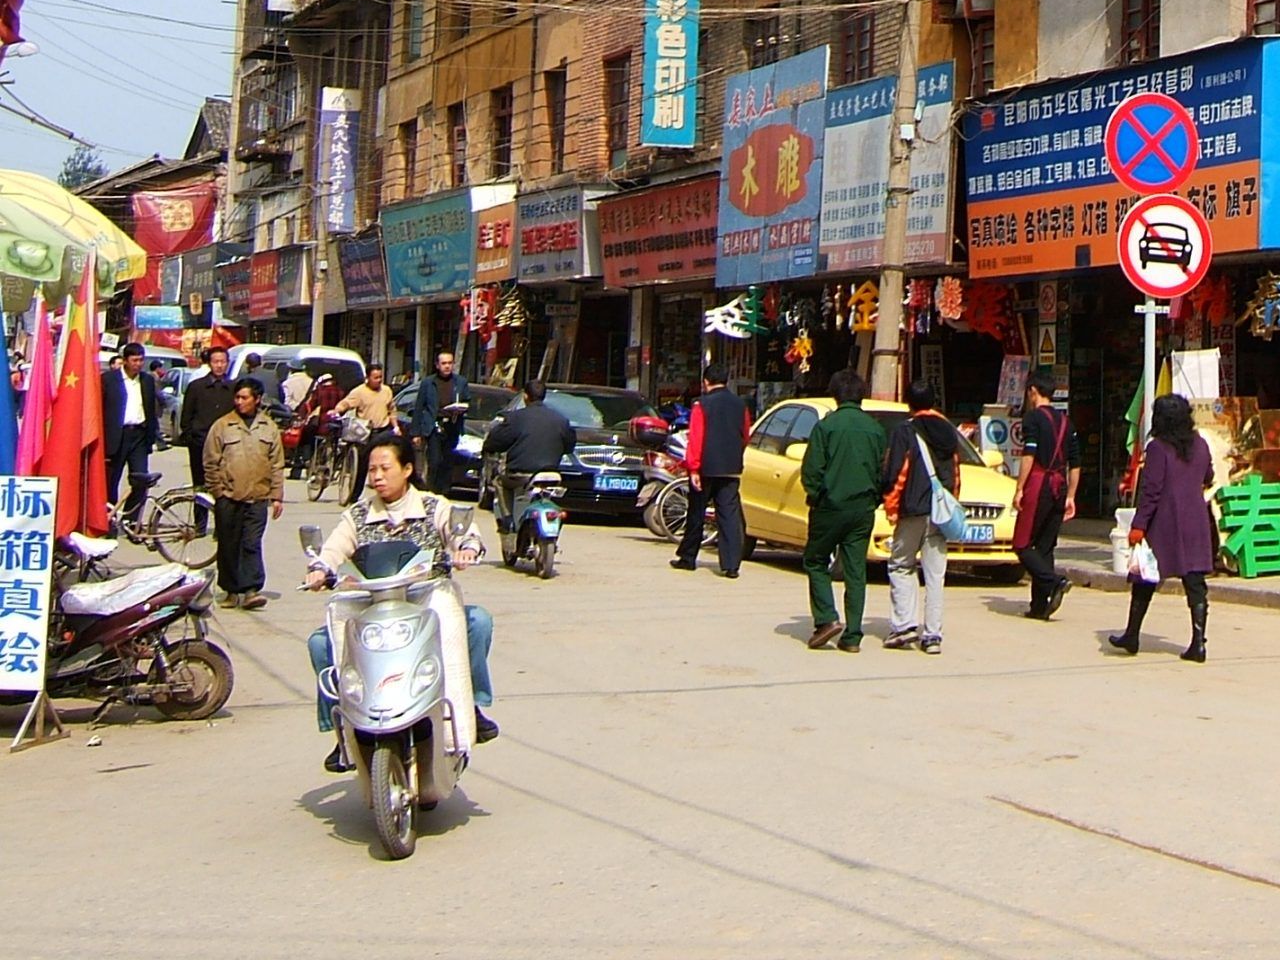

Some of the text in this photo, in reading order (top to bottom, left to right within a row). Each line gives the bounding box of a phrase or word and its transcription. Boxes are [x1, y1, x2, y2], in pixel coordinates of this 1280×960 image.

[740, 135, 800, 209] 木雕
[970, 213, 1018, 248] 写真喷绘
[1024, 204, 1075, 244] 各种字牌
[1082, 200, 1108, 237] 灯箱
[1226, 177, 1257, 218] 旗子
